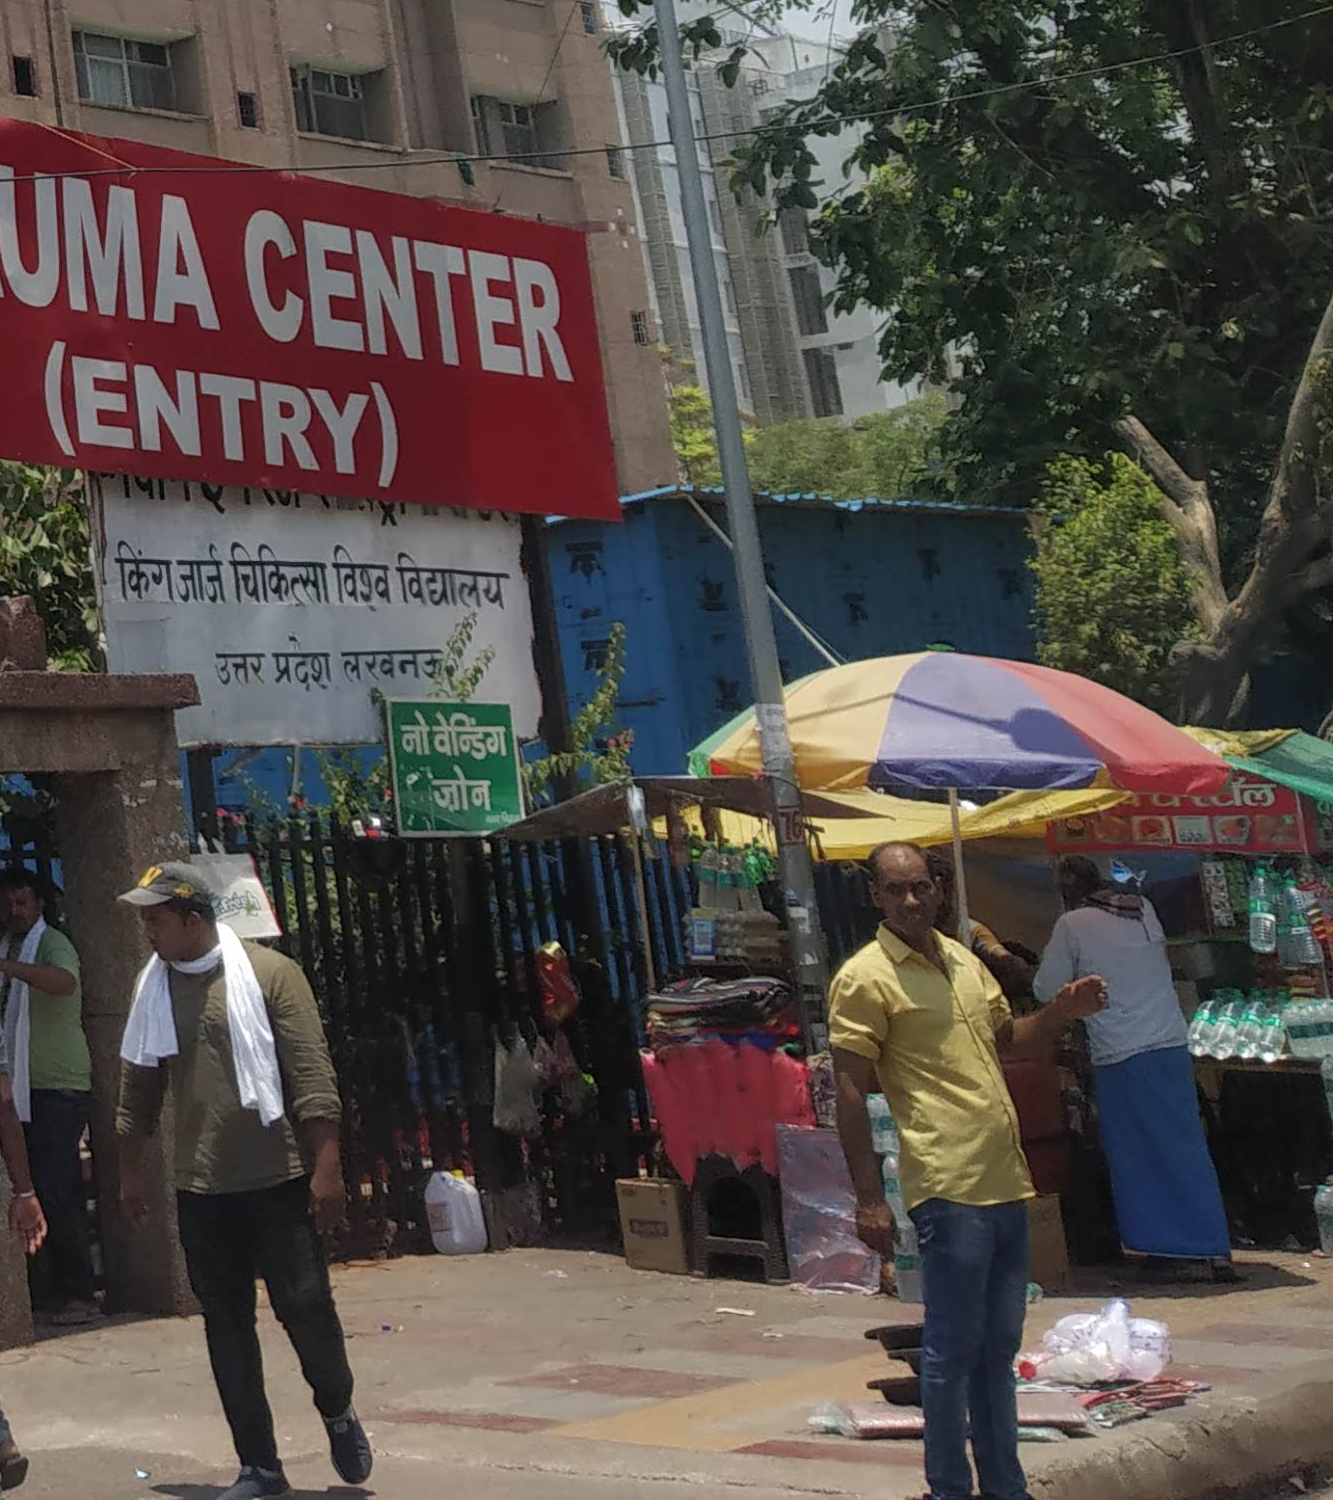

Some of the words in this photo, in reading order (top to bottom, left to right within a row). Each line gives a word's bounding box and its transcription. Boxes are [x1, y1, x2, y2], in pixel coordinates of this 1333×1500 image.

[244, 209, 575, 382] CENTER
[44, 340, 399, 488] (ENTRY)
[114, 540, 173, 603] किंग
[176, 543, 226, 603] जार्ज
[229, 542, 331, 607] चिकित्सा
[332, 544, 389, 612] विश्व
[396, 552, 512, 610] विद्यालय
[214, 652, 266, 685] उत्तर
[270, 632, 332, 692] प्रदेश
[399, 709, 431, 756] नो
[431, 710, 508, 761] वेन्डिंग
